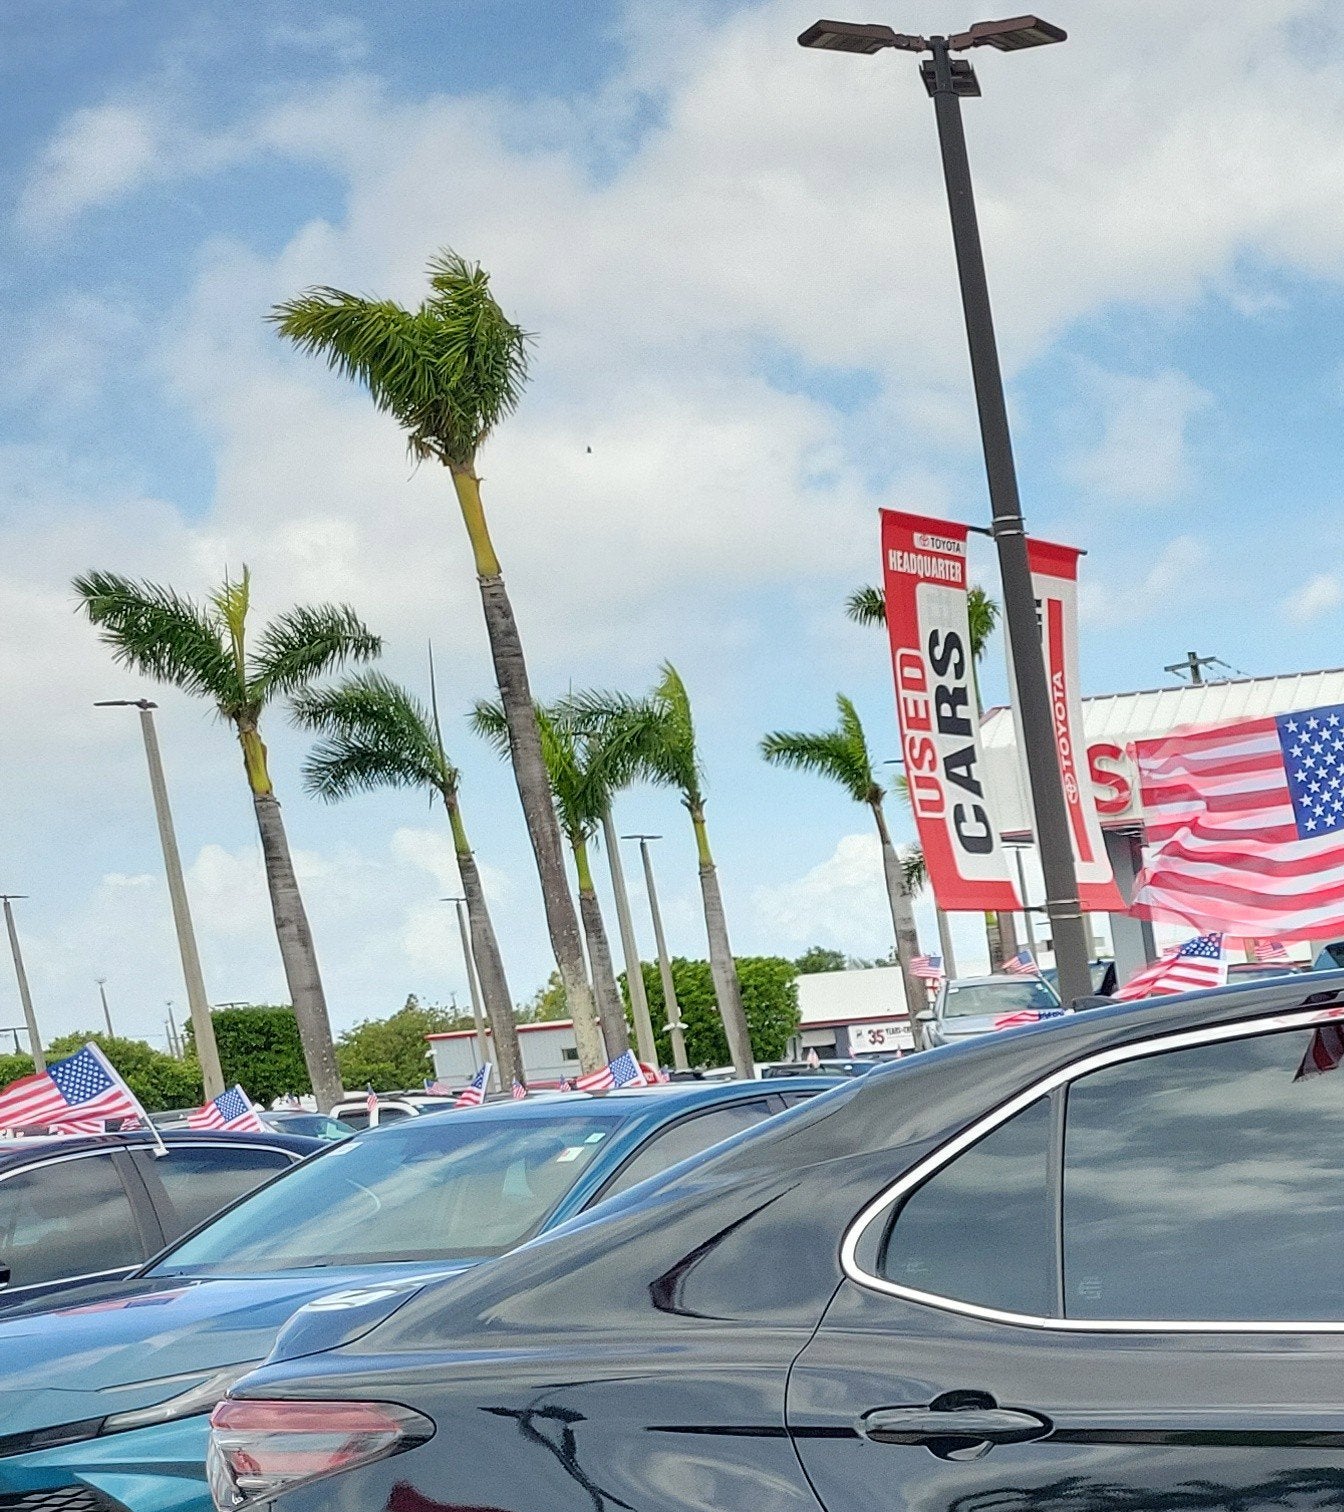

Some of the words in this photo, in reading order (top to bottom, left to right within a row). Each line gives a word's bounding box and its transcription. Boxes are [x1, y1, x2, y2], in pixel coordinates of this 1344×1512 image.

[888, 550, 962, 582] HEADQUARTER
[930, 537, 961, 552] TOYOTA
[897, 650, 945, 817] USED
[928, 628, 994, 855] CARS
[1052, 670, 1072, 770] TOYOTA
[868, 1028, 885, 1045] 35
